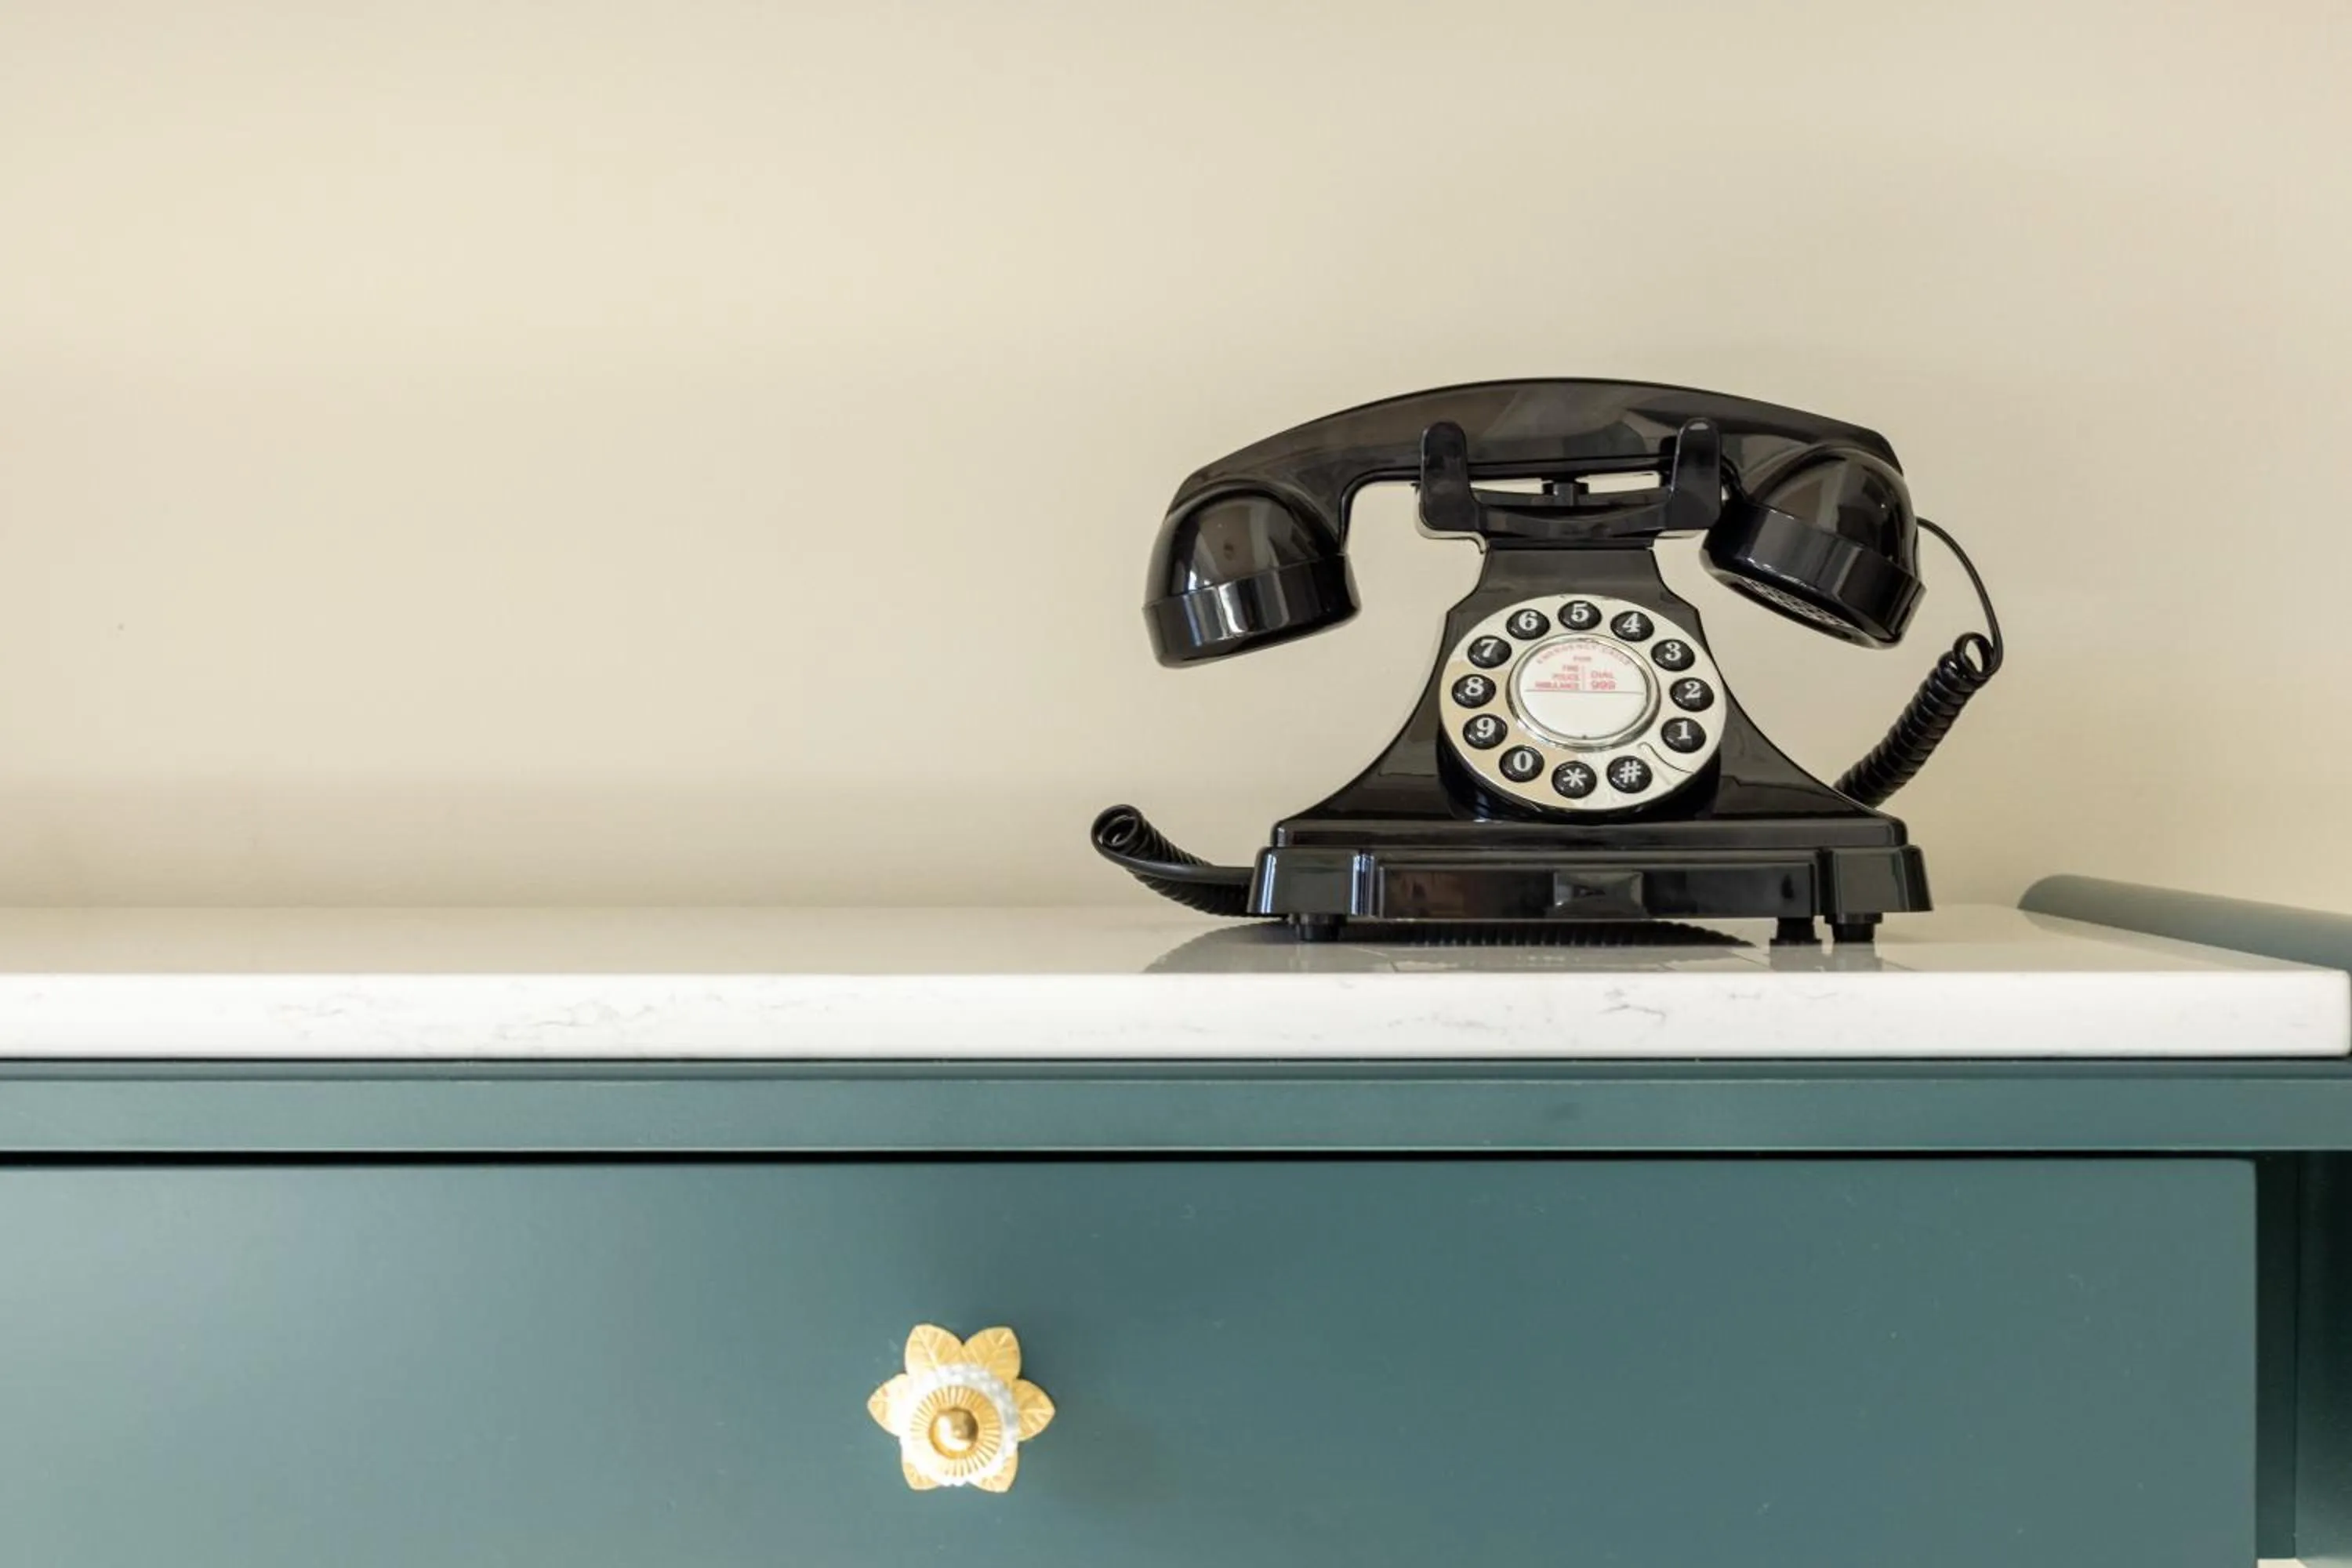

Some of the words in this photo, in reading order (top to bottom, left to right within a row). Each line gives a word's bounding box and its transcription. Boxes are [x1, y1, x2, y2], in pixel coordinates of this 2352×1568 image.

[1519, 611, 1538, 631] 6
[1571, 603, 1589, 622] 5
[1622, 612, 1641, 633] 4
[1479, 639, 1498, 658] 7
[1664, 641, 1682, 661] 3
[1465, 677, 1484, 696] 8
[1684, 681, 1701, 699] 2
[1476, 717, 1496, 738] 9
[1675, 720, 1692, 740] 1
[1513, 750, 1534, 772] 0
[1619, 760, 1642, 783] #
